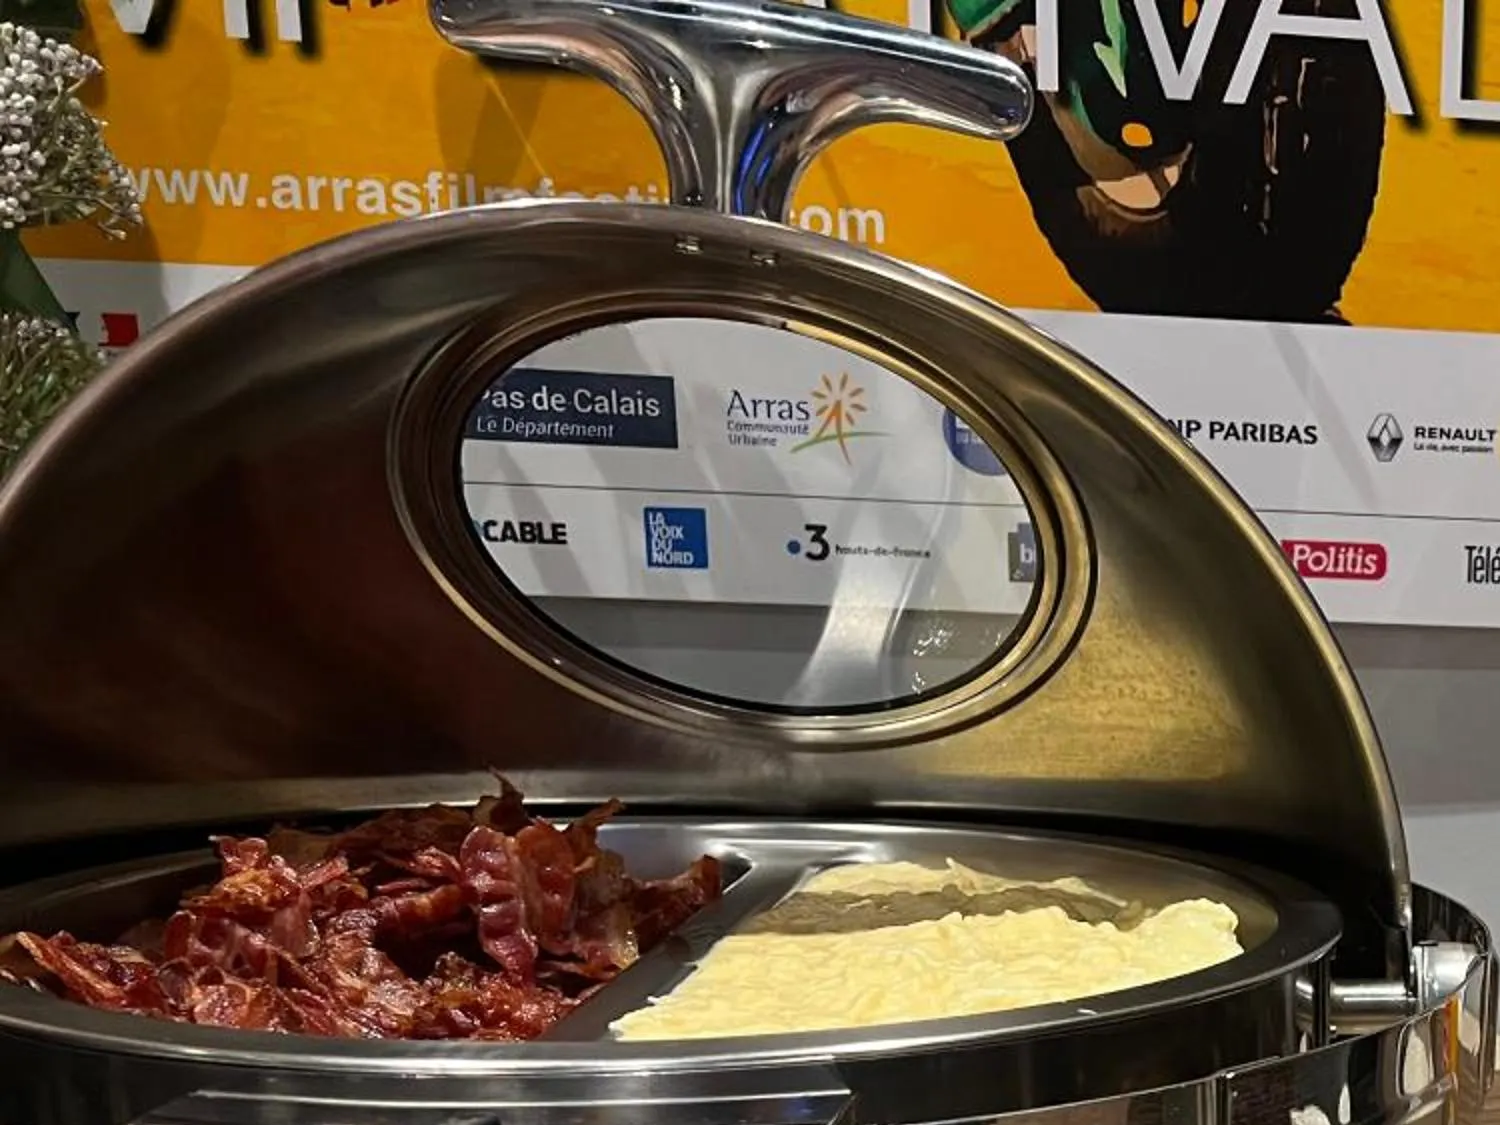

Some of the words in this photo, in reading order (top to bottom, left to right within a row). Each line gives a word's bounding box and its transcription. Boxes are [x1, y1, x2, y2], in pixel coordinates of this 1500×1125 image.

[482, 388, 525, 410] as
[531, 385, 567, 412] de
[572, 387, 661, 417] Calais
[726, 389, 811, 421] Arras
[476, 416, 498, 433] Le
[502, 416, 614, 439] Département
[1208, 420, 1319, 446] PARIBAS
[1413, 425, 1499, 442] RENAULT
[649, 511, 666, 526] LA
[476, 519, 568, 545] CABLE
[651, 525, 685, 540] VOIX
[803, 524, 830, 562] 3
[651, 538, 673, 551] DU
[651, 550, 695, 565] NORD
[1292, 543, 1379, 575] Politis
